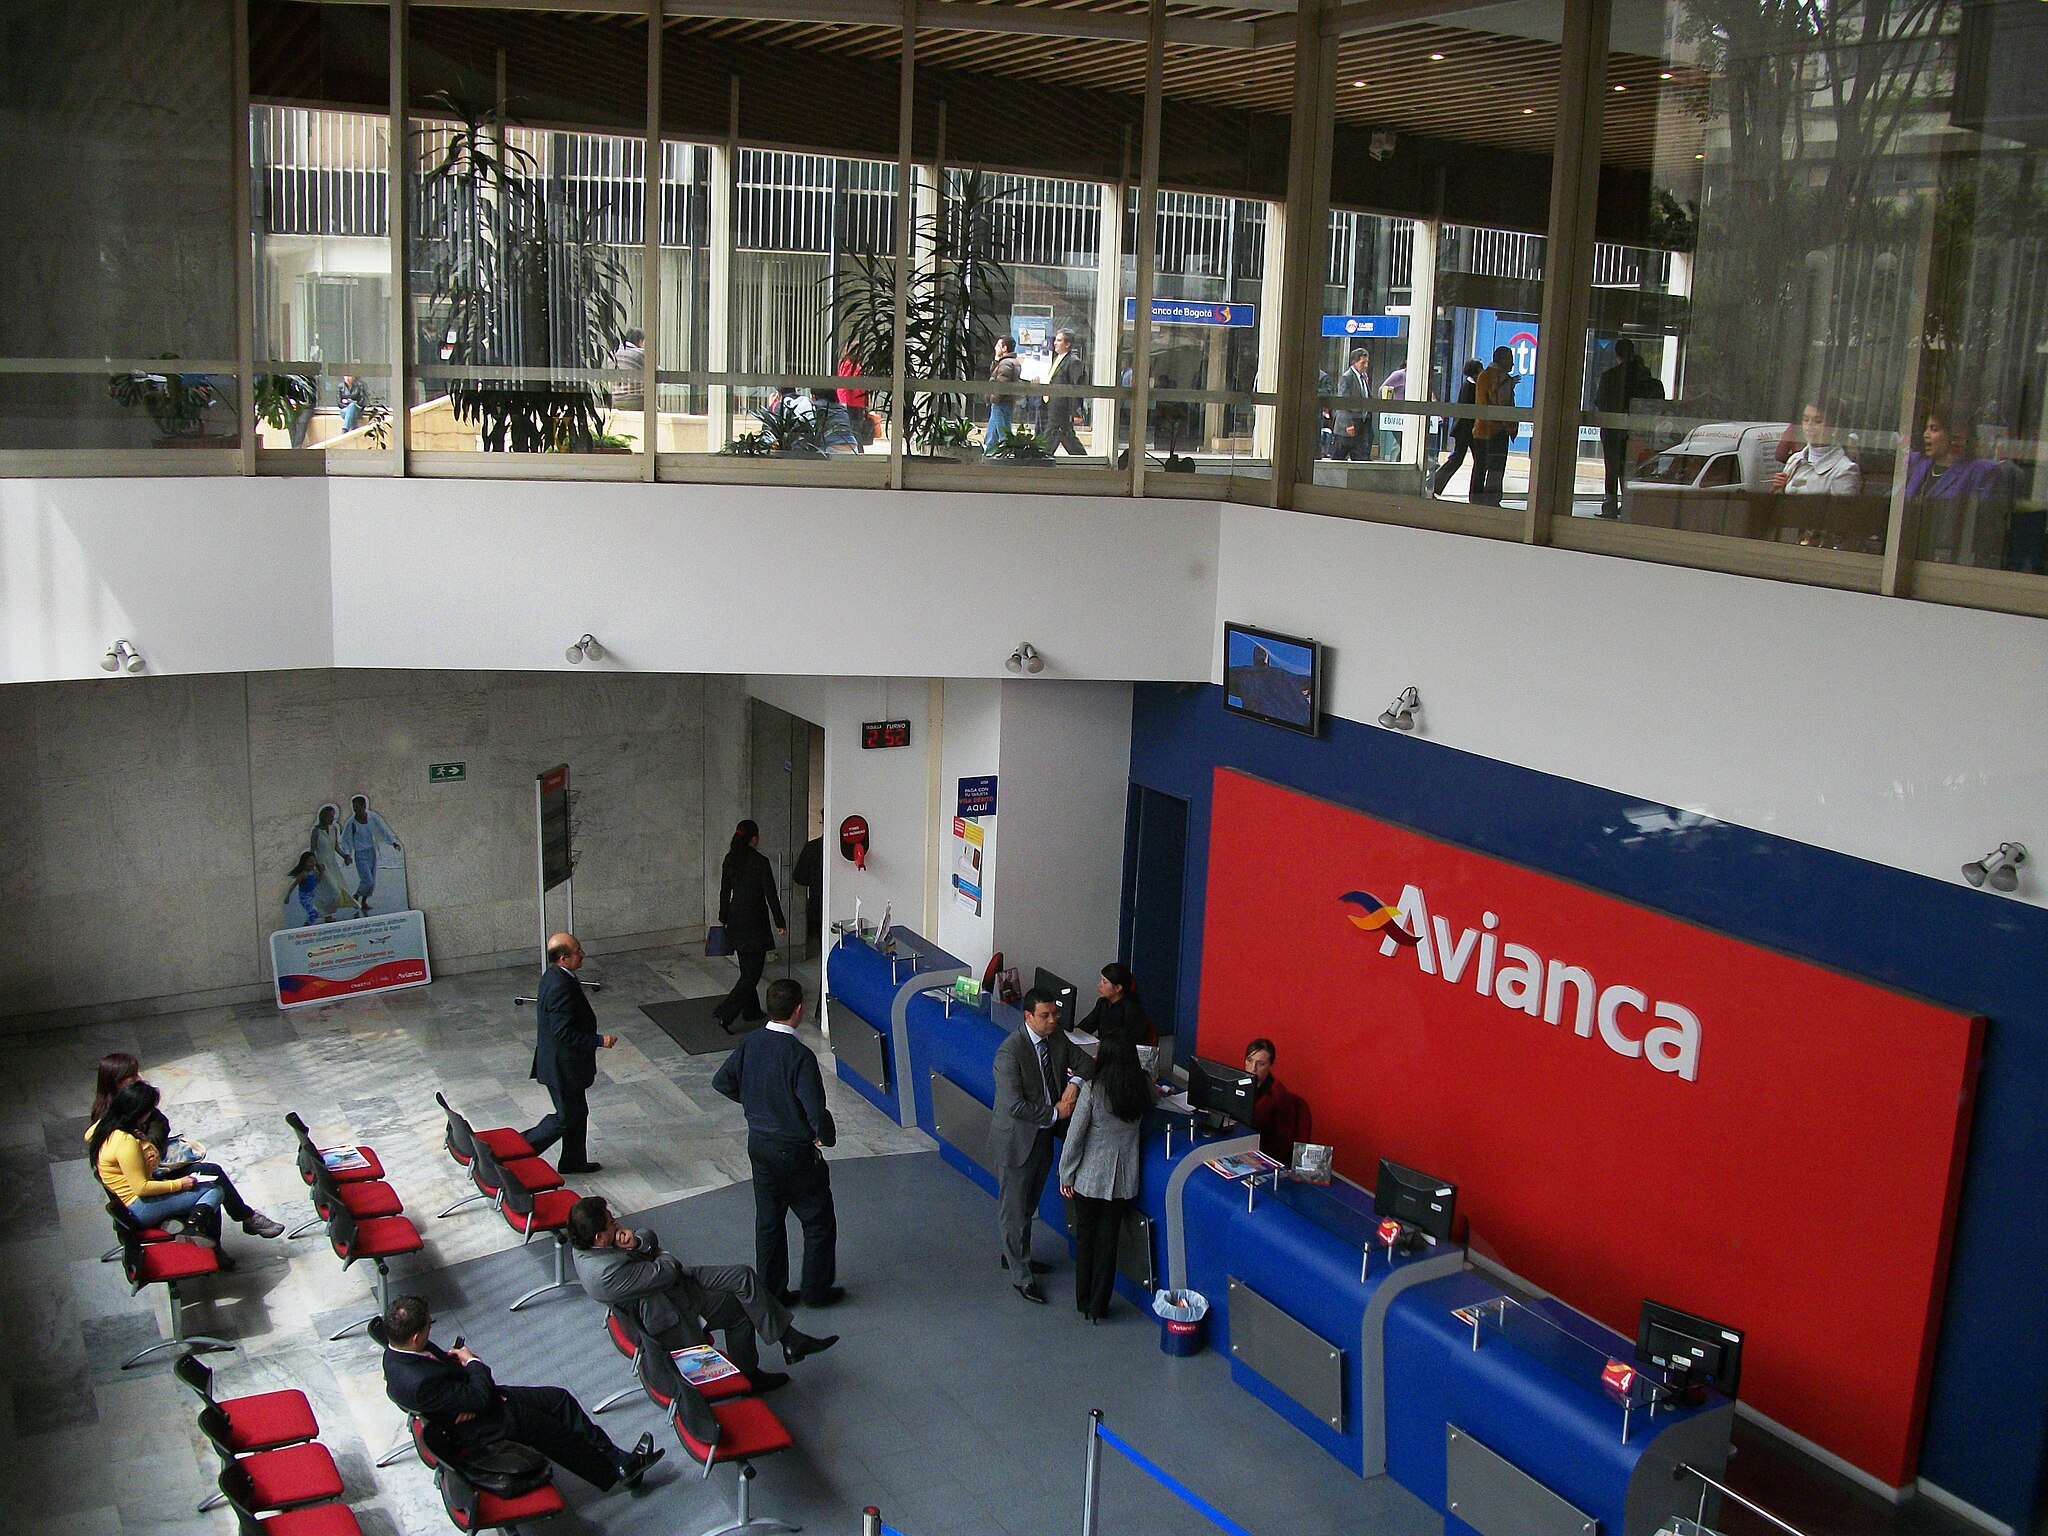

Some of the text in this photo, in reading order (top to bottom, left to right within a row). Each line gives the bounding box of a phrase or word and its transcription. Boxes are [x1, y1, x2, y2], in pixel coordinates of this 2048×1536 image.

[1173, 307, 1182, 315] de
[1184, 307, 1212, 318] Bogotá
[867, 730, 878, 747] 2
[967, 802, 988, 812] AQUÍ
[397, 970, 423, 980] Avianca
[1378, 884, 1702, 1082] Avianca
[1621, 1372, 1632, 1390] 4
